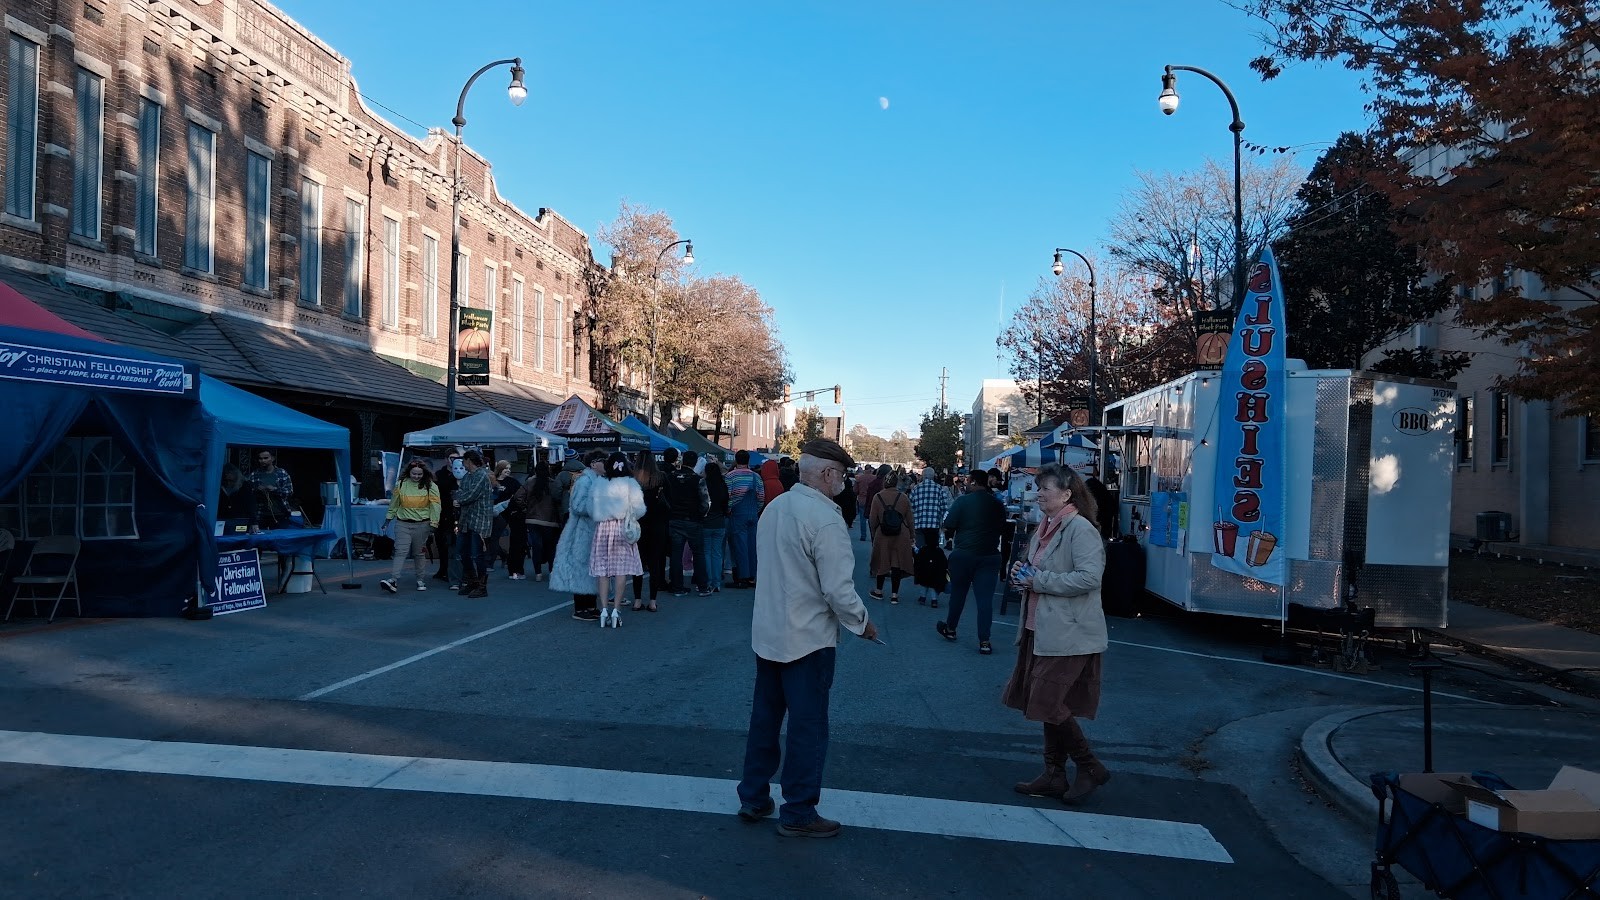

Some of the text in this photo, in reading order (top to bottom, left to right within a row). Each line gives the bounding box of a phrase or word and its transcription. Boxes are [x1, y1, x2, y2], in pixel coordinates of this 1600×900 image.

[26, 354, 86, 369] CHRISTIAN
[90, 361, 153, 376] FELLOWSHIP
[36, 366, 58, 374] place
[68, 370, 89, 378] HOPE,
[90, 372, 109, 380] LOVE
[154, 368, 182, 381] Prayer
[157, 377, 181, 388] Booth
[1399, 412, 1429, 431] BBQ
[231, 553, 241, 562] To
[223, 565, 256, 581] Christian
[224, 579, 261, 596] Fellowship
